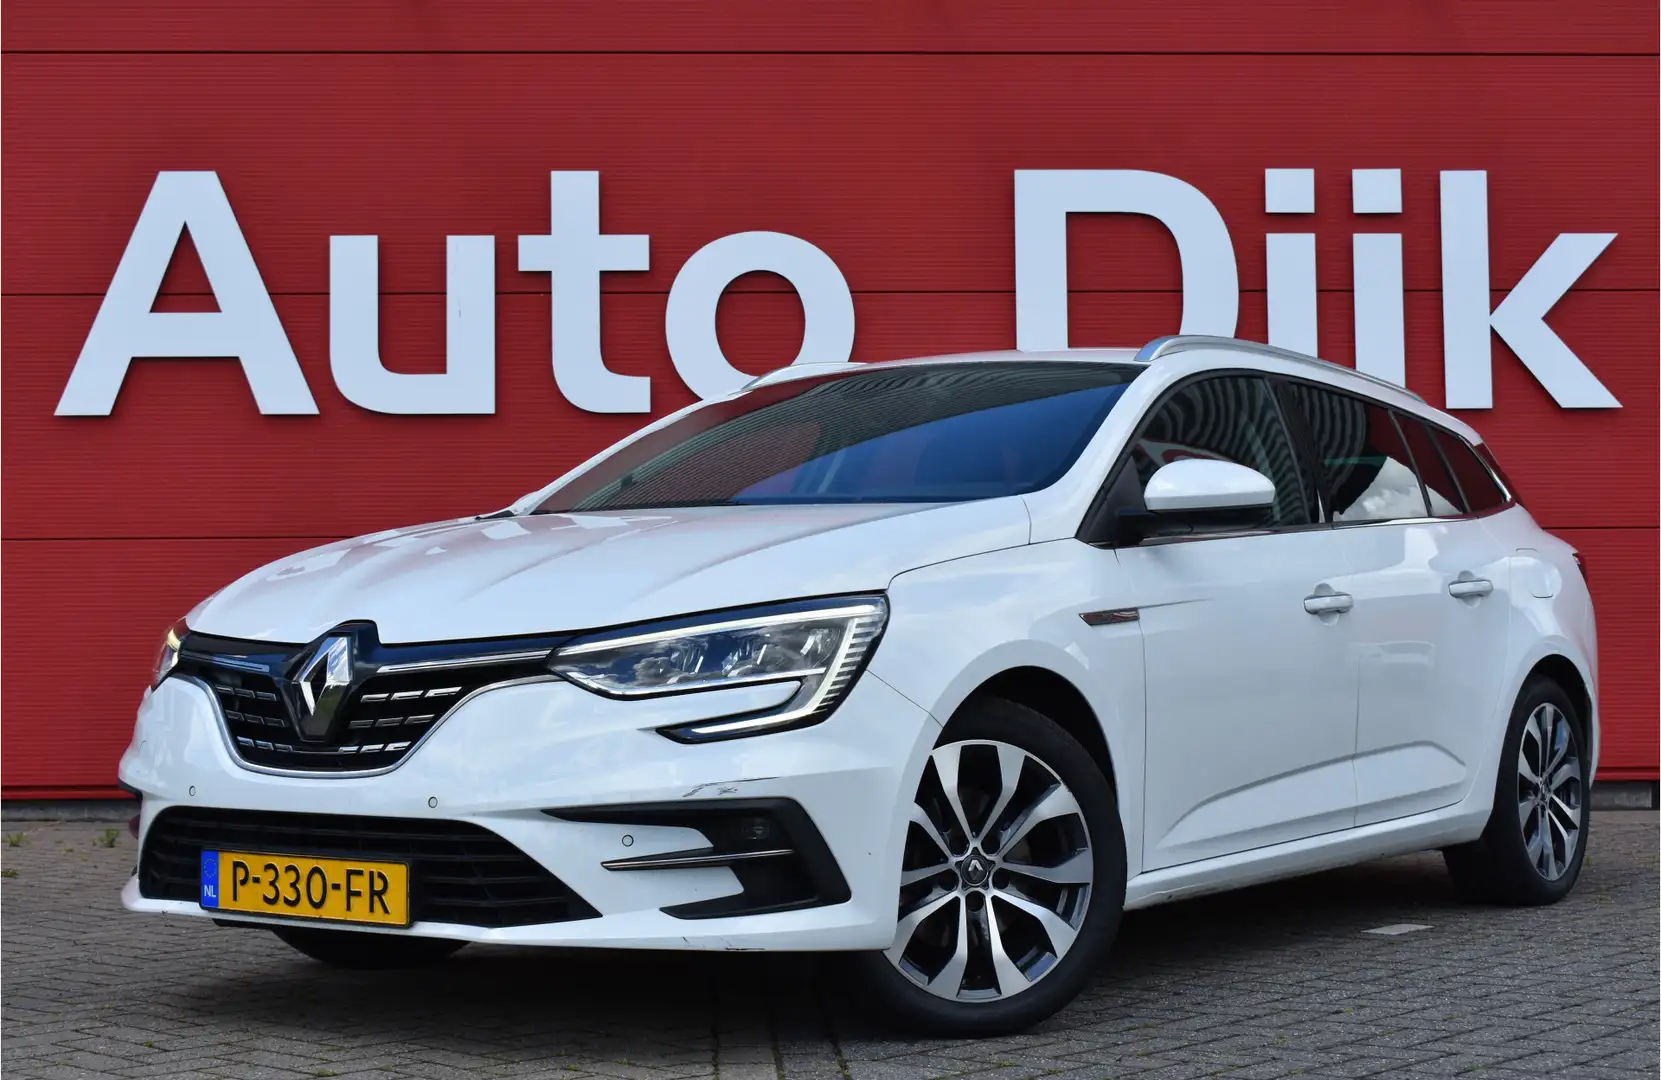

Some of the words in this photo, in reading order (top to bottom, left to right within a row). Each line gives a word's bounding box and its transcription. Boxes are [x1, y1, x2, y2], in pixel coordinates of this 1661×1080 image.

[54, 170, 855, 416] Auto
[203, 884, 217, 898] NL
[232, 860, 391, 914] P-330-FR
